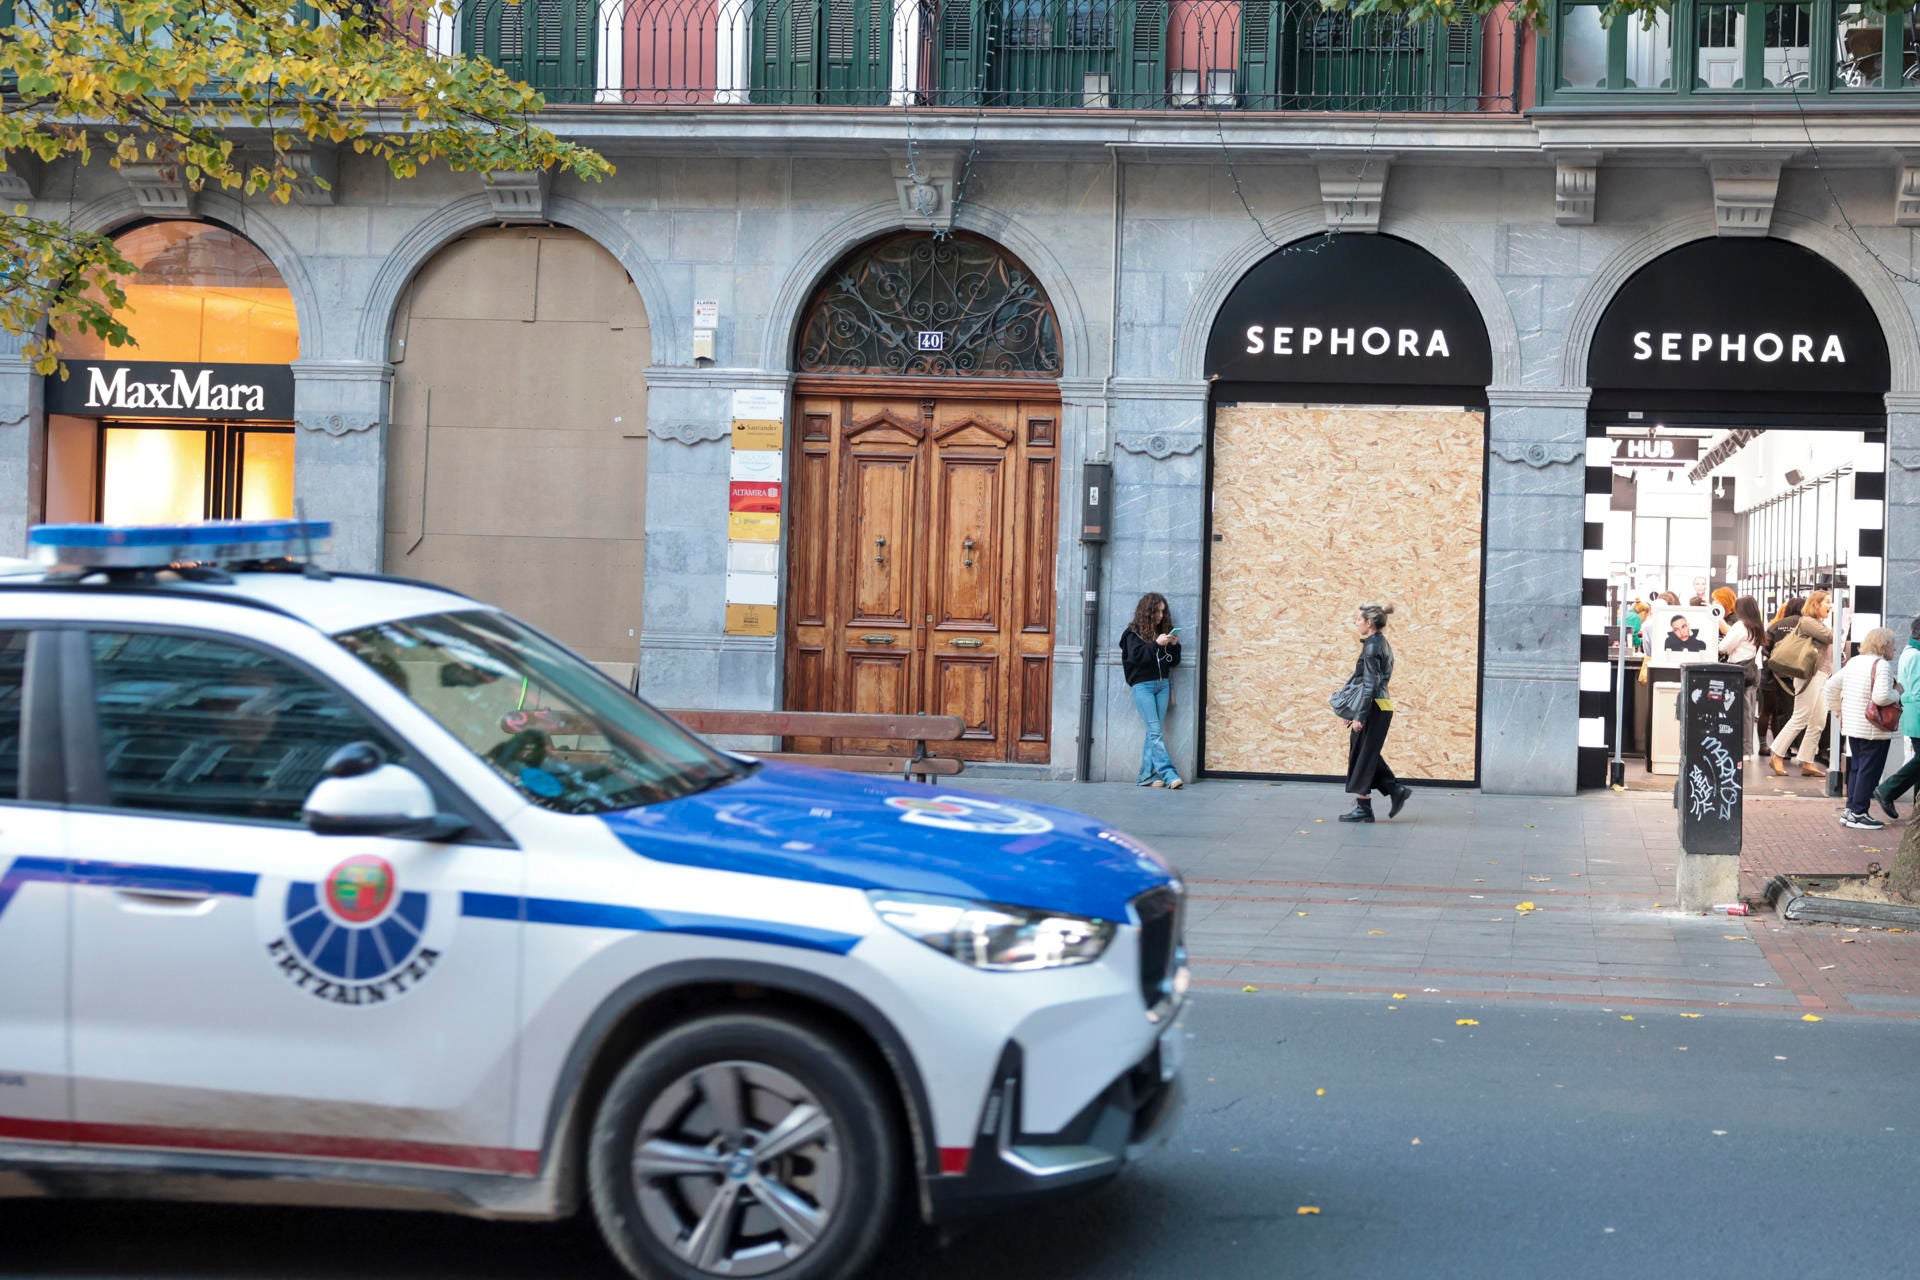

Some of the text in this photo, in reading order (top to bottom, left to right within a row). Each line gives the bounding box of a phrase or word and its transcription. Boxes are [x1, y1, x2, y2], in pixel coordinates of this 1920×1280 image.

[921, 334, 940, 348] 40
[1246, 325, 1450, 357] SEPHORA
[1633, 331, 1847, 364] SEPHORA
[85, 367, 265, 411] MaxMara
[746, 423, 777, 431] Santander
[1627, 440, 1675, 458] HUB
[732, 488, 767, 497] ALTAMIRA
[266, 937, 442, 1006] ERTZAINTZA
